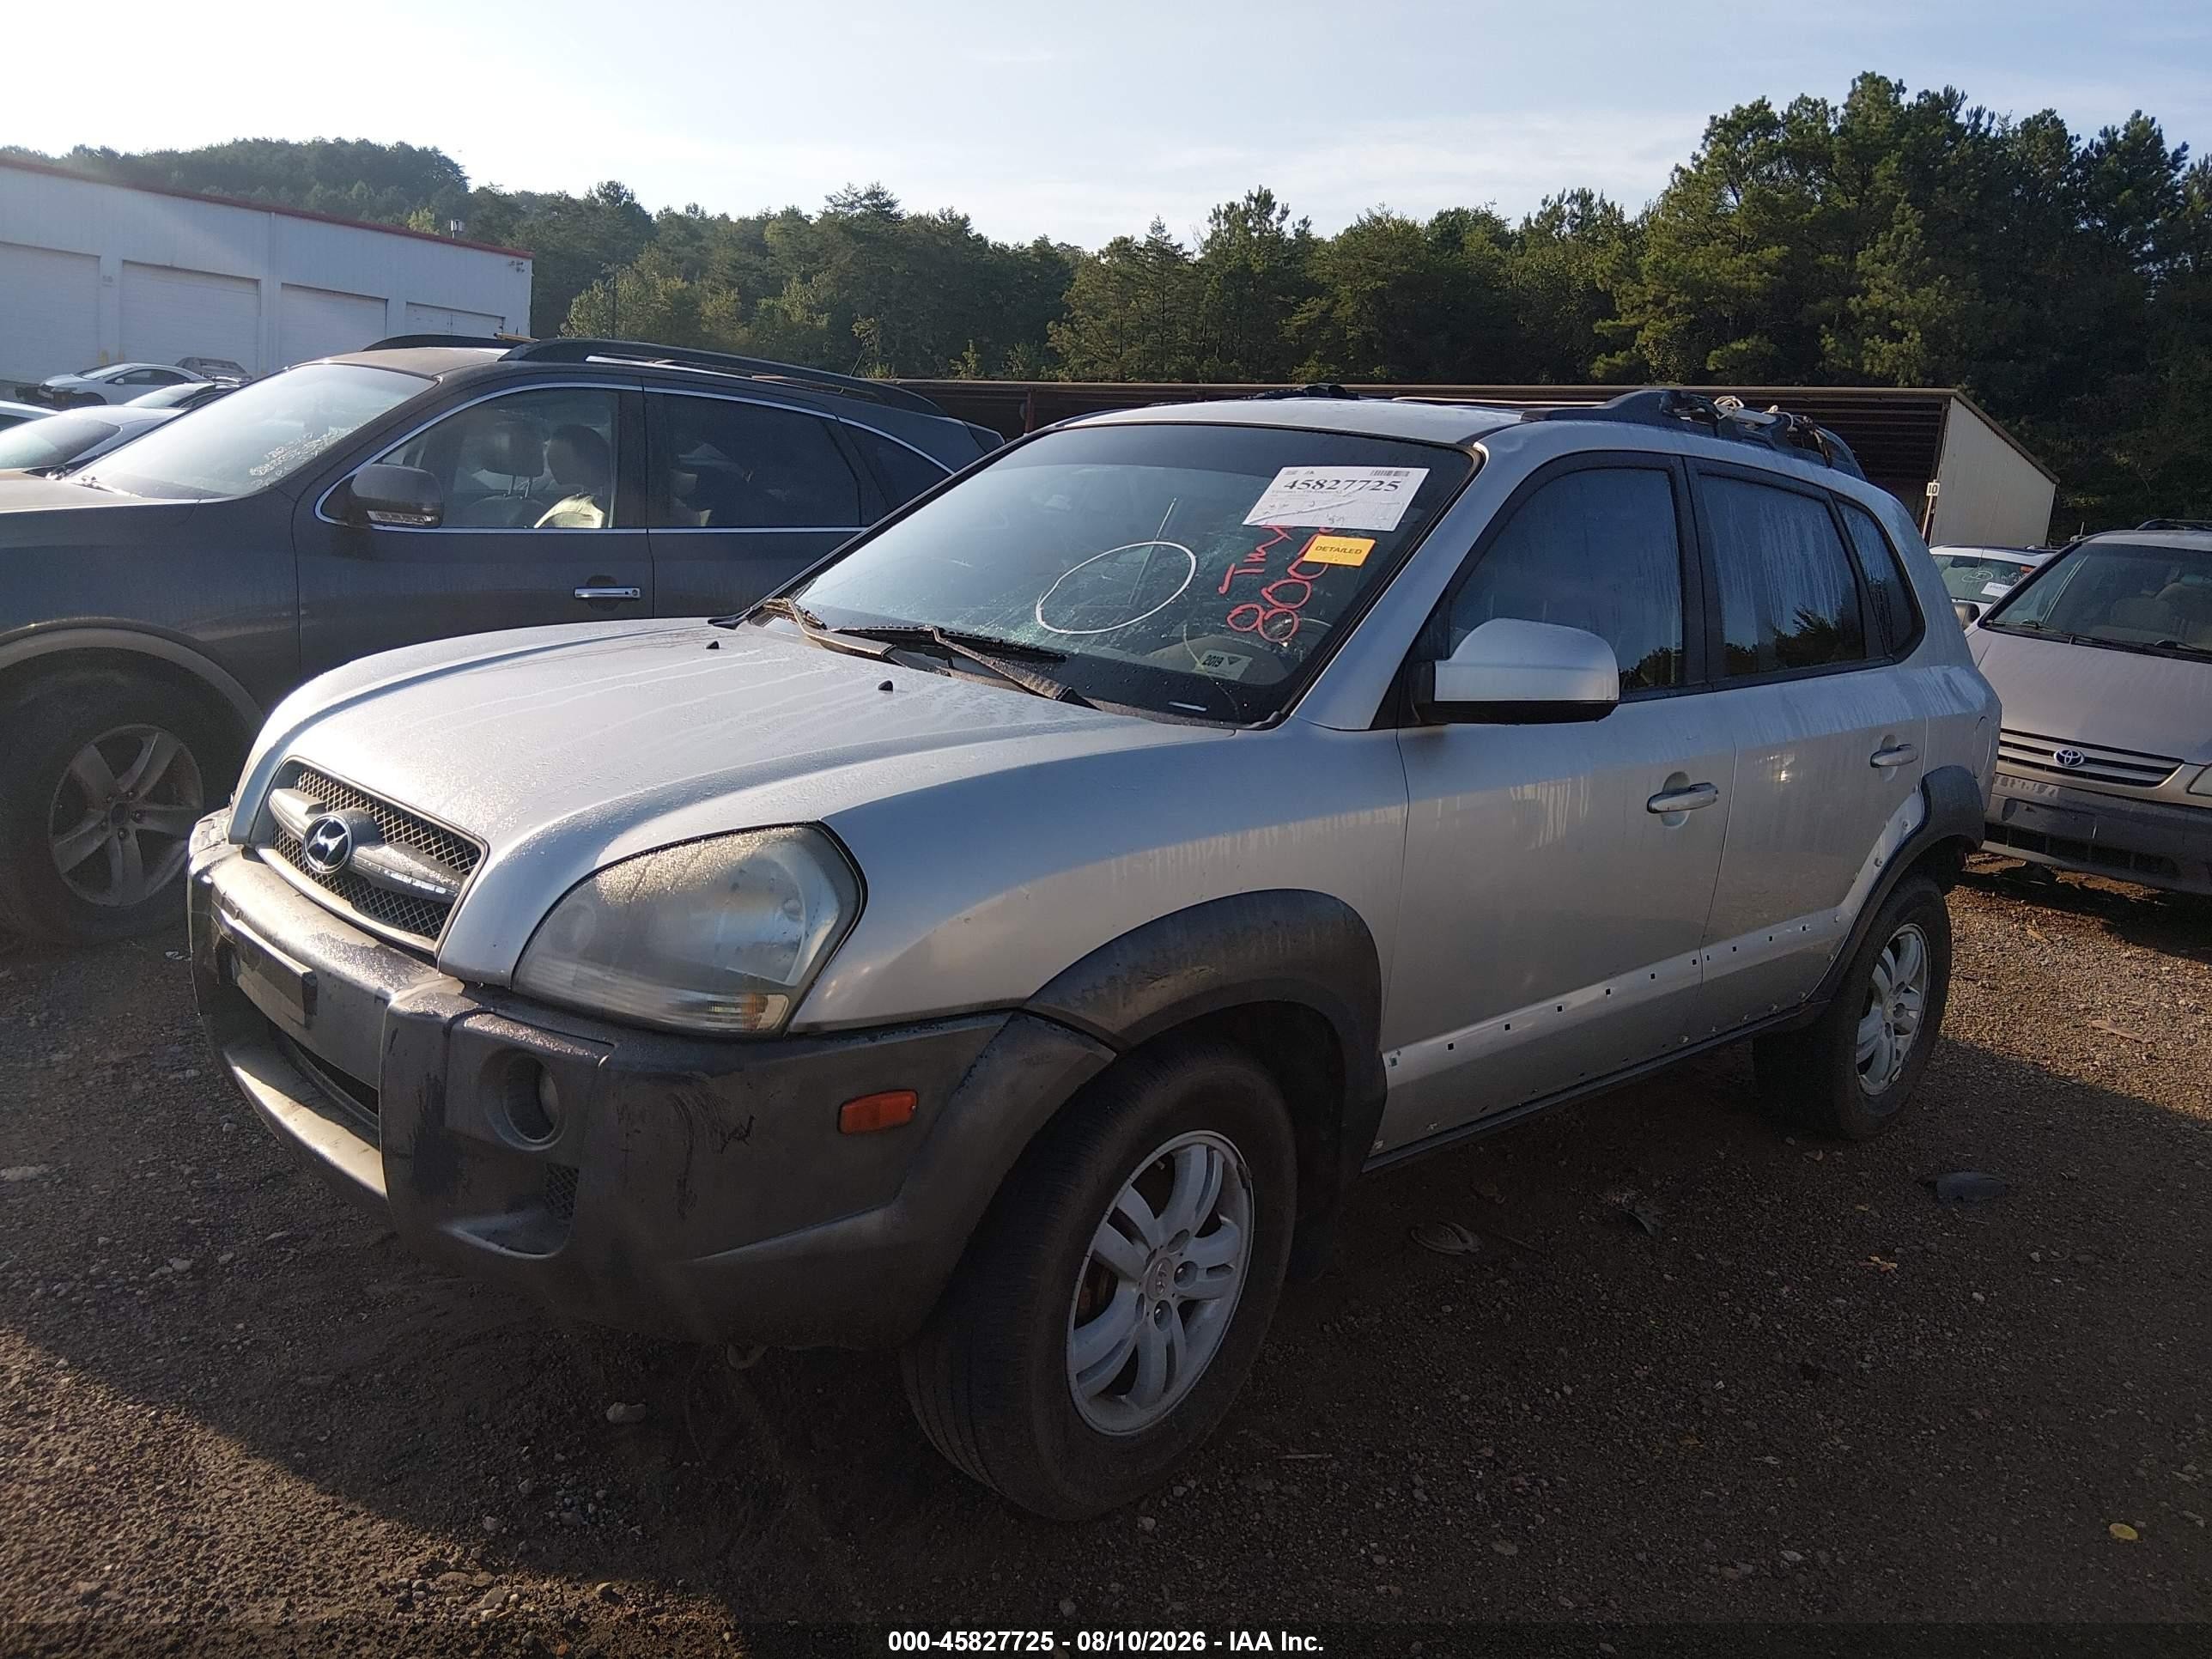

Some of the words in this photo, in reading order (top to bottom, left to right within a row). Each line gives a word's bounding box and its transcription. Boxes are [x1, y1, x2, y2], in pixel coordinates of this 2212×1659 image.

[1284, 478, 1402, 492] 45827725
[1928, 484, 1938, 495] 10
[1315, 545, 1363, 555] DETAILED
[1202, 654, 1224, 668] 2019
